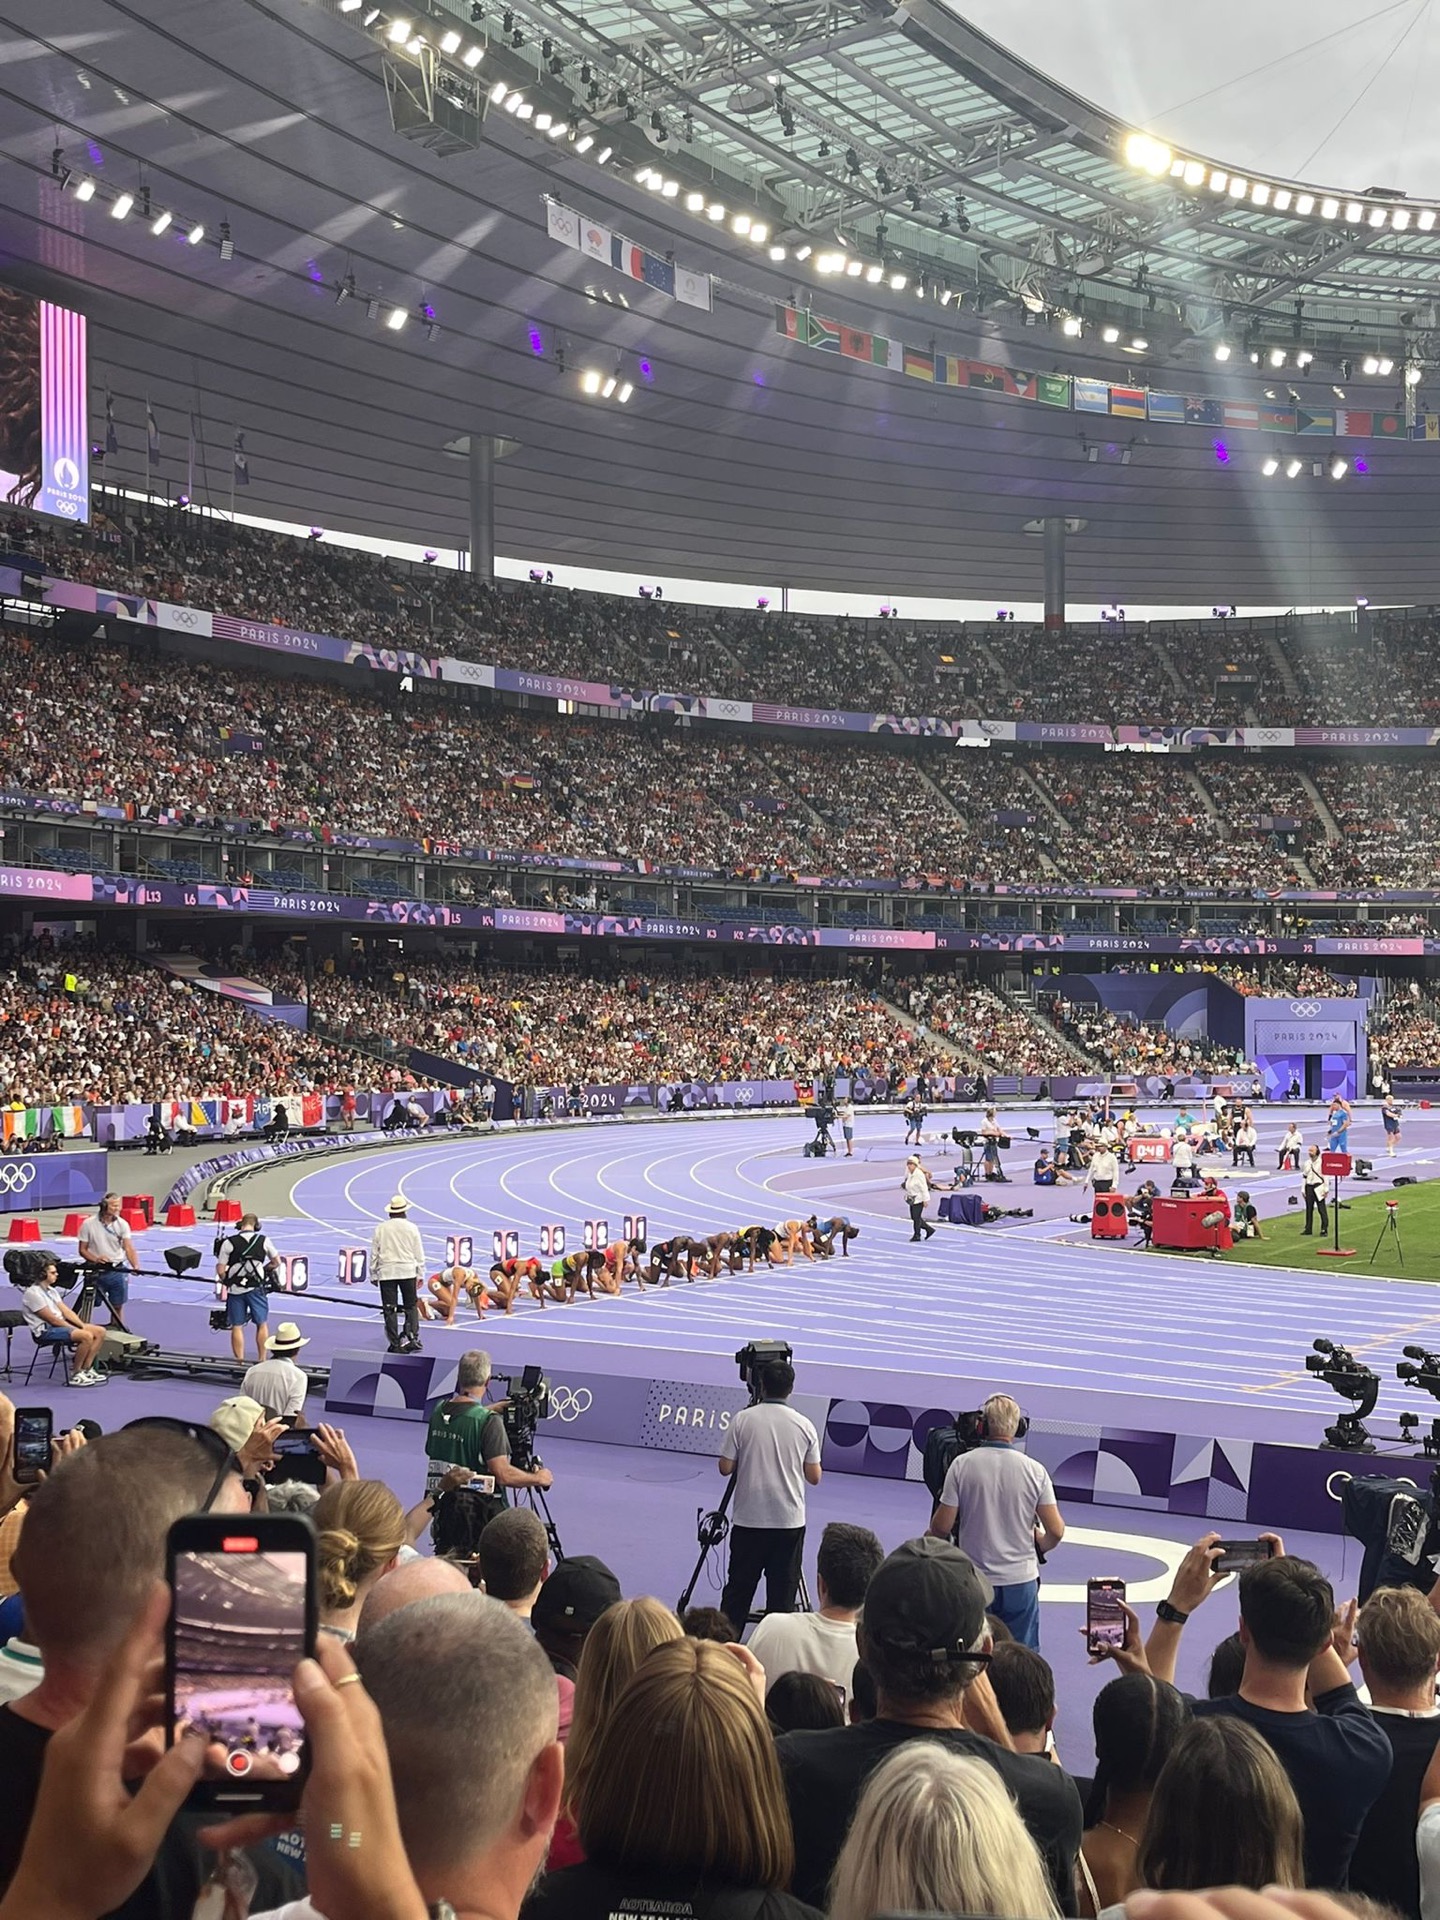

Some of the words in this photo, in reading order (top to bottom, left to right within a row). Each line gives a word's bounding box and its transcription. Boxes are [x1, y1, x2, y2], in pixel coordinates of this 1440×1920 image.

[240, 626, 279, 644] PARIS
[284, 634, 318, 651] 2024
[519, 677, 552, 691] PARIS
[556, 682, 586, 696] 2024
[776, 711, 810, 723] PARIS
[814, 713, 845, 725] 2024
[1041, 727, 1077, 737] PARIS
[1322, 732, 1359, 742] PARIS
[1364, 732, 1399, 742] 2024
[0, 874, 22, 888] RIS
[27, 876, 62, 892] 2024
[146, 890, 161, 903] L13
[184, 893, 196, 905] L6
[274, 896, 307, 910] PARIS
[310, 900, 340, 912] 2024
[451, 913, 461, 924] L5
[482, 915, 494, 926] K4
[502, 914, 530, 926] PARIS
[533, 916, 559, 927] 2024
[647, 923, 674, 934] PARIS
[676, 925, 700, 936] 2024
[706, 929, 717, 939] K3
[733, 930, 744, 940] K2
[849, 933, 877, 943] PARIS
[879, 935, 904, 944] 2024
[937, 938, 947, 947] K1
[1090, 939, 1119, 948] PARIS
[1122, 940, 1150, 949] 2024
[1337, 942, 1369, 951] PARIS
[1372, 942, 1403, 951] 2024
[583, 1093, 615, 1108] 2024
[554, 1230, 564, 1254] 3
[459, 1241, 471, 1266] 5
[352, 1254, 365, 1279] 7
[292, 1262, 306, 1287] 8
